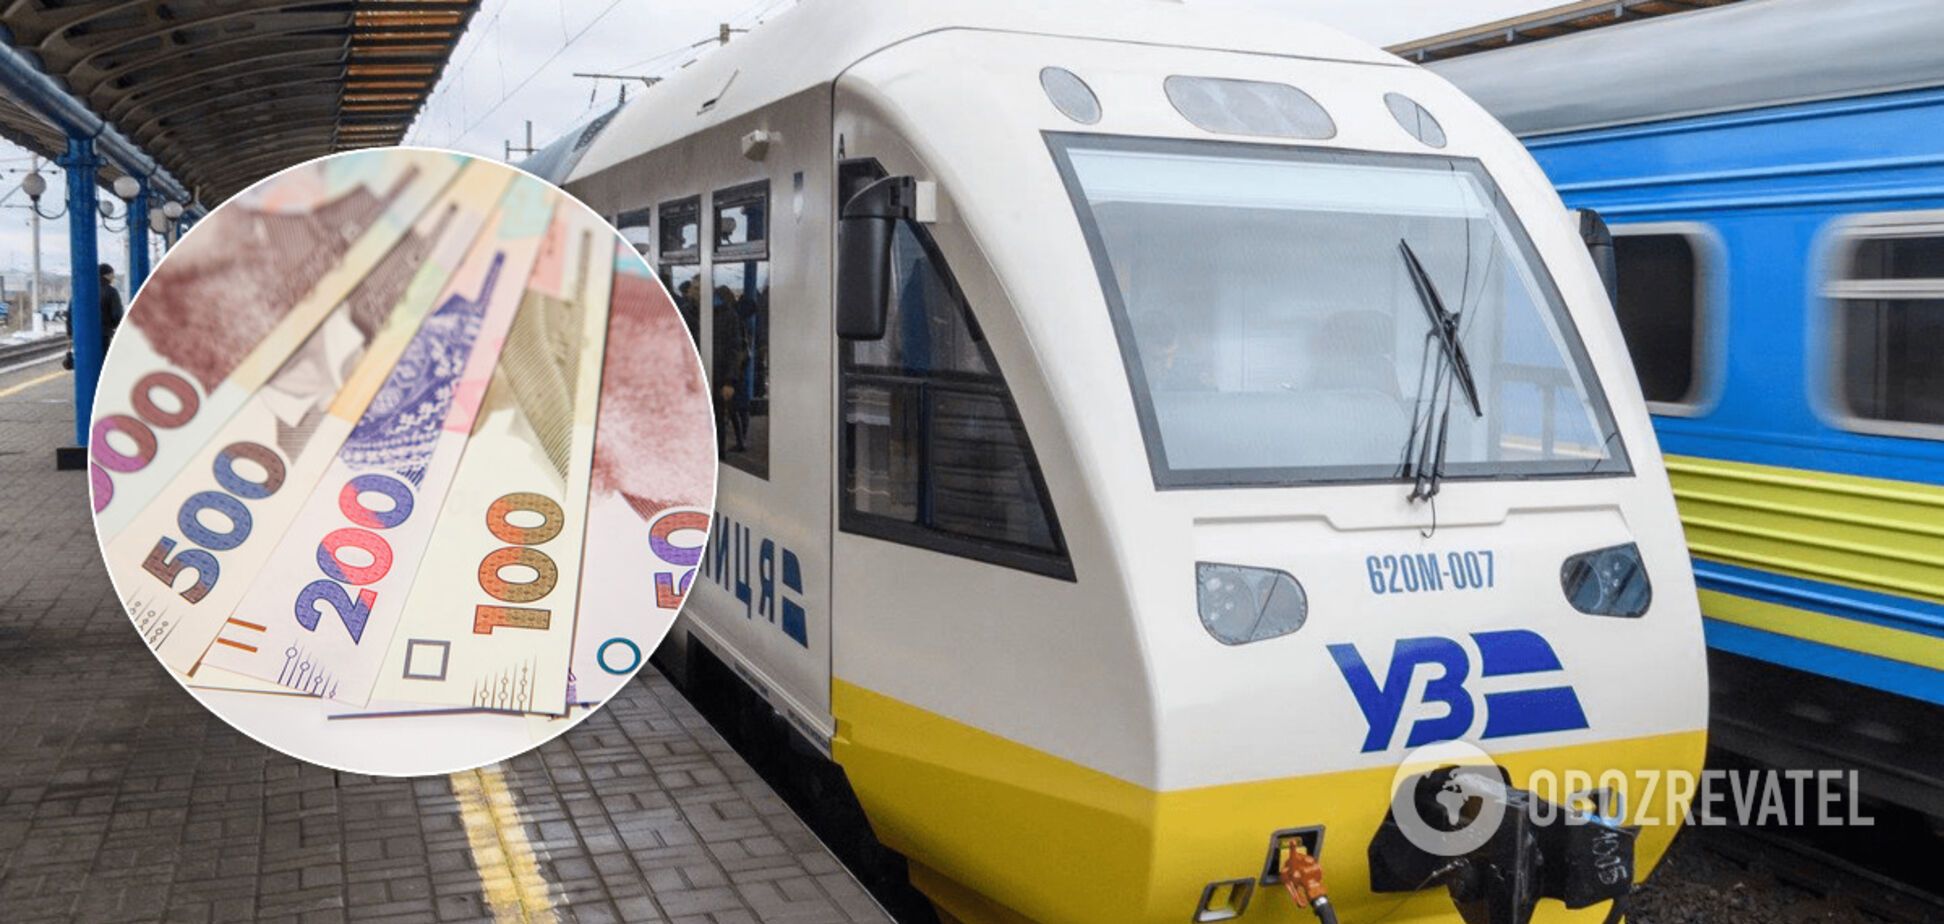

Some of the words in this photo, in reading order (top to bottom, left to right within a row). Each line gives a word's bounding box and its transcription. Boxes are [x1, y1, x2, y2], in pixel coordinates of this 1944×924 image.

[142, 441, 286, 604] 500
[295, 473, 415, 645] 200
[473, 492, 564, 634] 100
[700, 511, 775, 623] ИЦЯ
